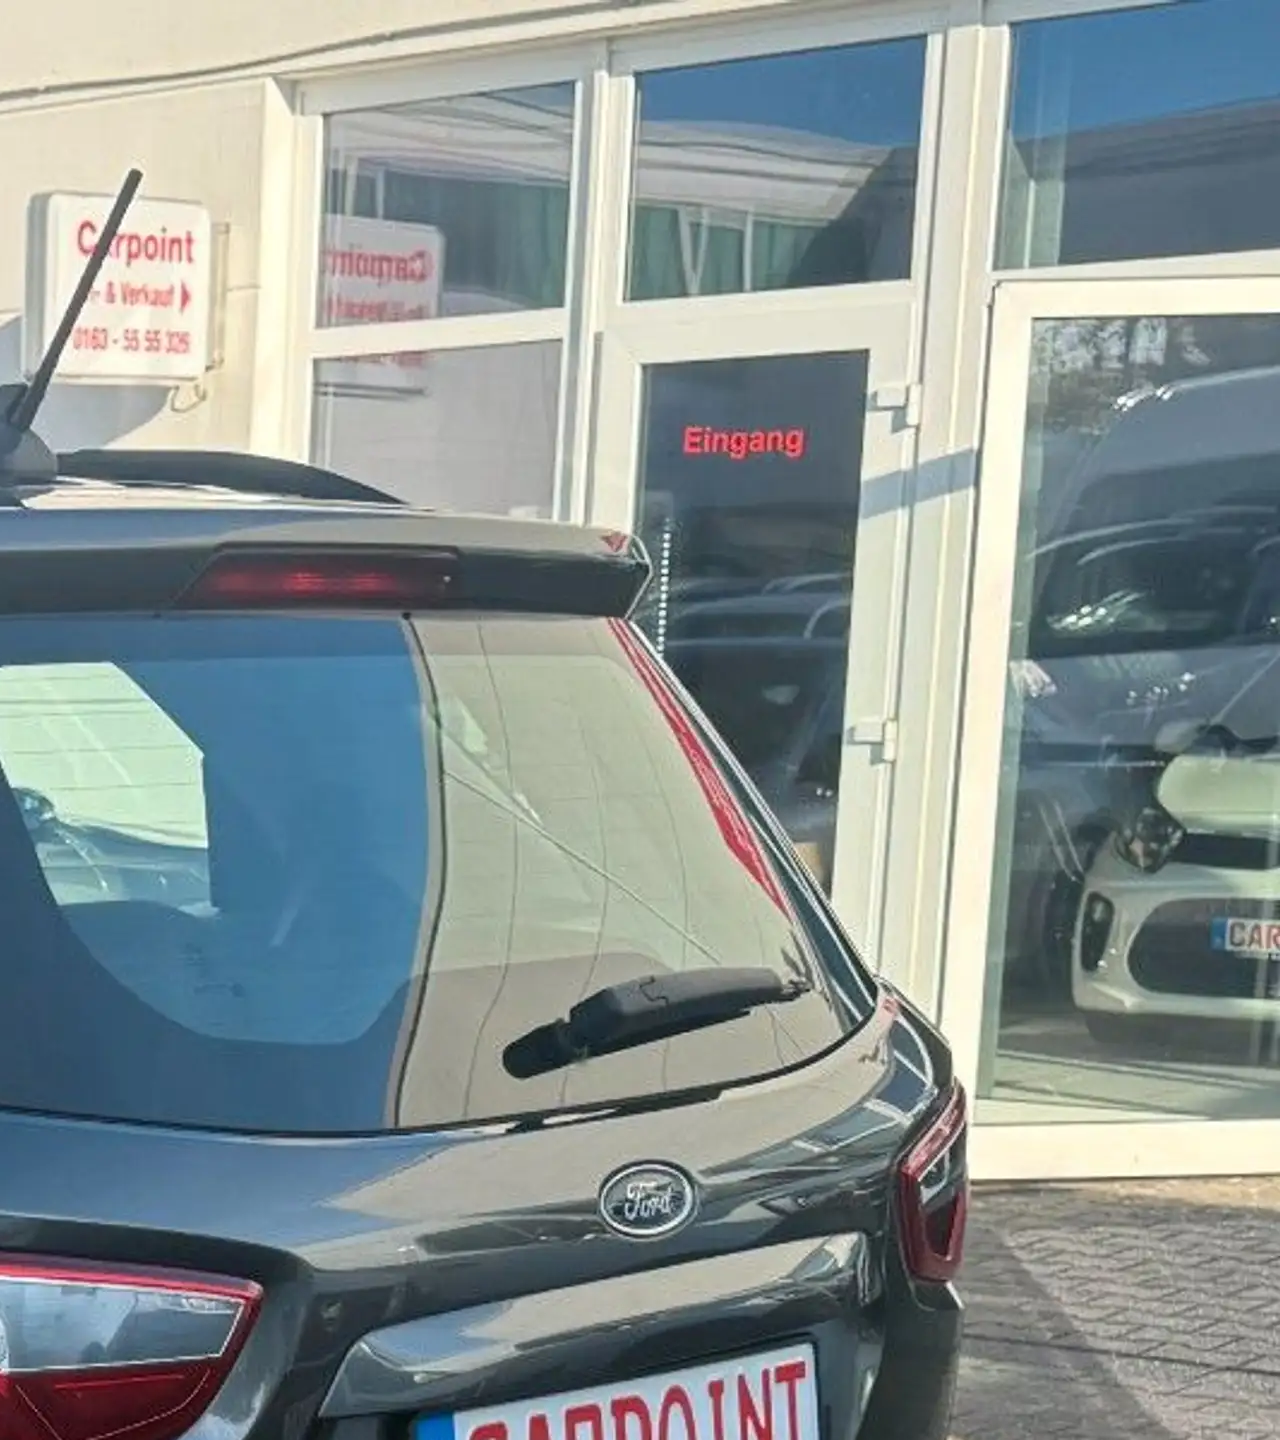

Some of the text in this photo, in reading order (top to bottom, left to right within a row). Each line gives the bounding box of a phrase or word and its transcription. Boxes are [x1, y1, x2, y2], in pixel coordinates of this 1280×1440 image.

[77, 219, 195, 267] Crpoint
[684, 426, 804, 459] Eingang
[624, 1181, 673, 1220] Ford
